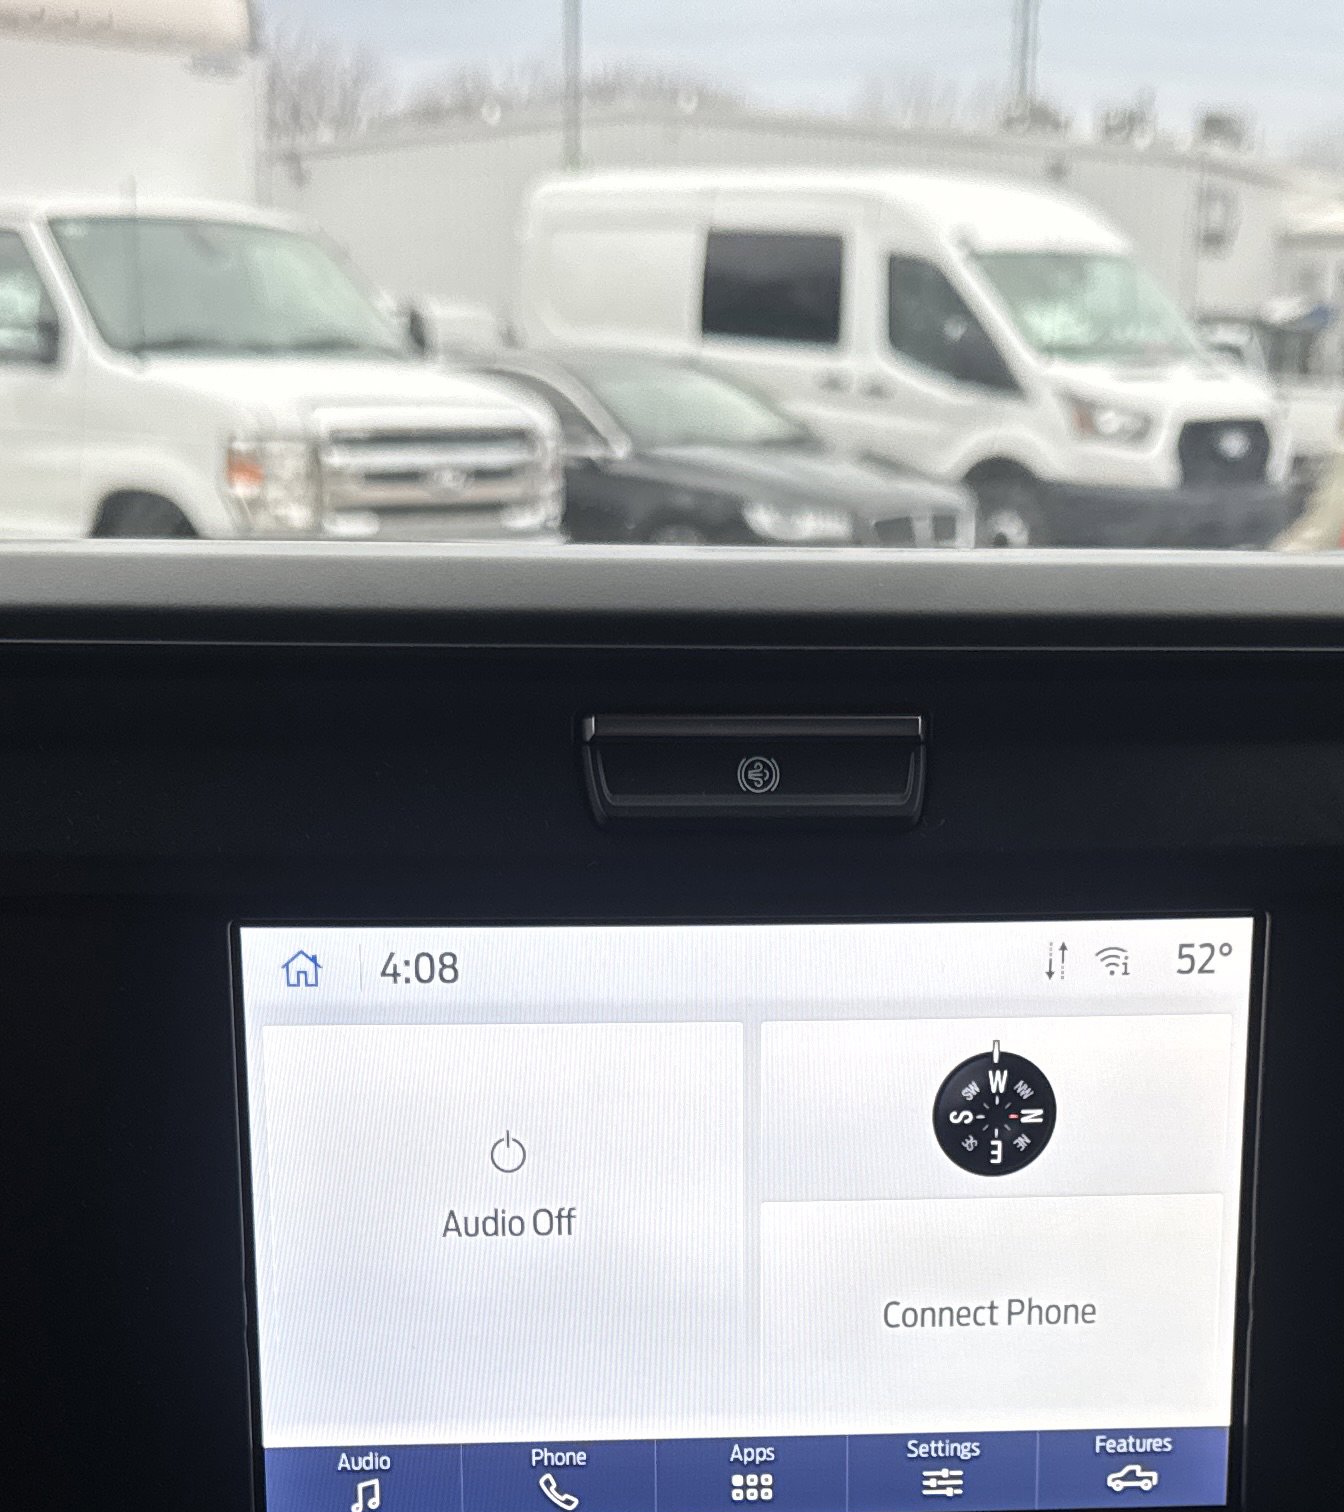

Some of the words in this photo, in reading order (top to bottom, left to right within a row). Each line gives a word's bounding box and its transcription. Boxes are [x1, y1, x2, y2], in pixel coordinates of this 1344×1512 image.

[379, 951, 459, 985] 4:08
[1176, 942, 1233, 975] 52°
[988, 1069, 1008, 1094] W
[949, 1110, 974, 1124] S
[1019, 1108, 1044, 1123] N
[989, 1140, 1003, 1164] E
[442, 1208, 525, 1238] Audio
[532, 1207, 577, 1237] Off
[883, 1299, 999, 1329] Connect
[1006, 1297, 1098, 1327] Phone
[729, 1443, 775, 1464] Apps
[906, 1439, 981, 1460] Settings
[1095, 1435, 1172, 1454] Features
[337, 1452, 391, 1472] Audio
[531, 1448, 587, 1468] Phone
